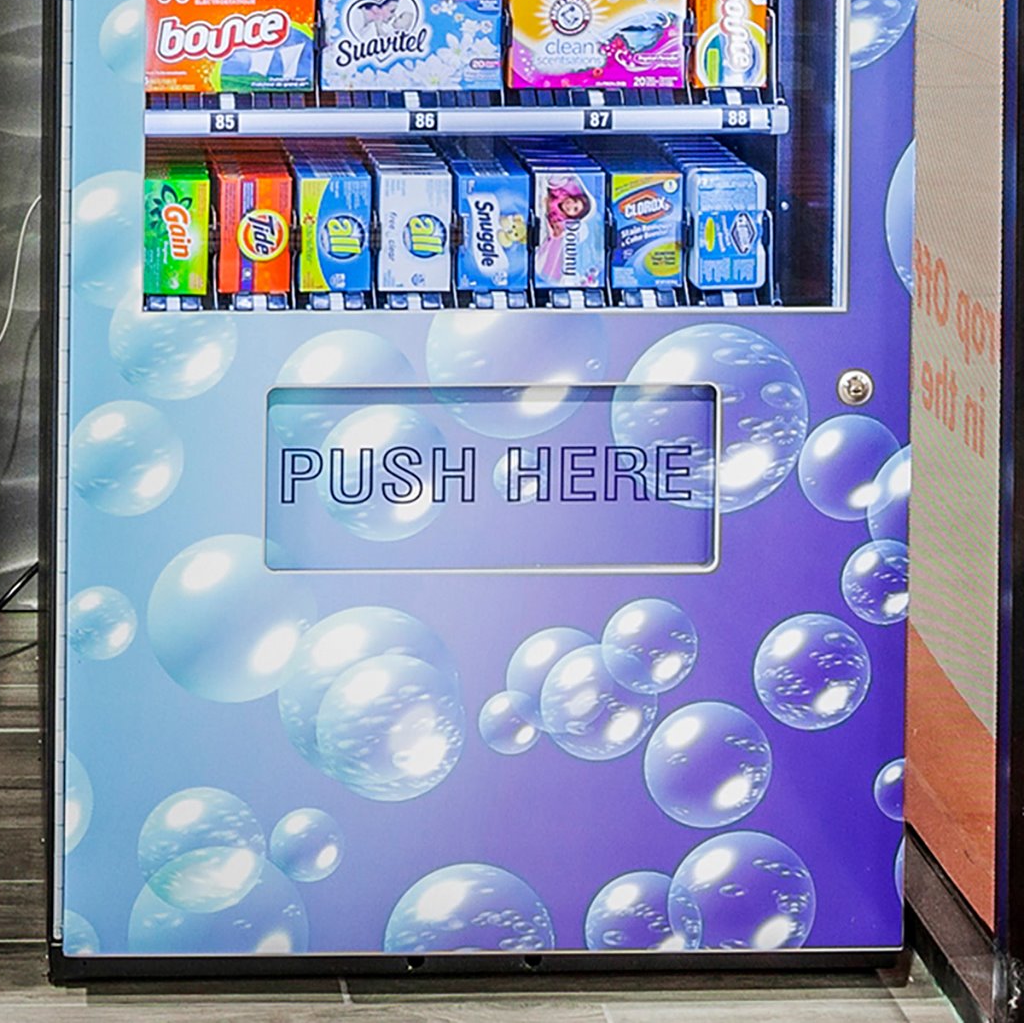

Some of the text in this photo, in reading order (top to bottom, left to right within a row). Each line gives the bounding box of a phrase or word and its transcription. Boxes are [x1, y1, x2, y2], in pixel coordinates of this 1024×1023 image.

[159, 10, 284, 59] bounce
[336, 28, 428, 67] Suavitel
[545, 39, 595, 55] clean
[215, 114, 235, 130] 85
[415, 113, 435, 128] 86
[589, 111, 610, 127] 87
[728, 110, 748, 126] 88
[625, 199, 665, 218] CLOROX
[164, 205, 191, 258] Gain
[248, 215, 275, 255] Tide
[328, 218, 362, 254] all
[410, 217, 444, 254] all
[475, 200, 499, 267] Snuggle
[563, 220, 580, 277] Downy
[280, 445, 693, 505] PUSH HERE
